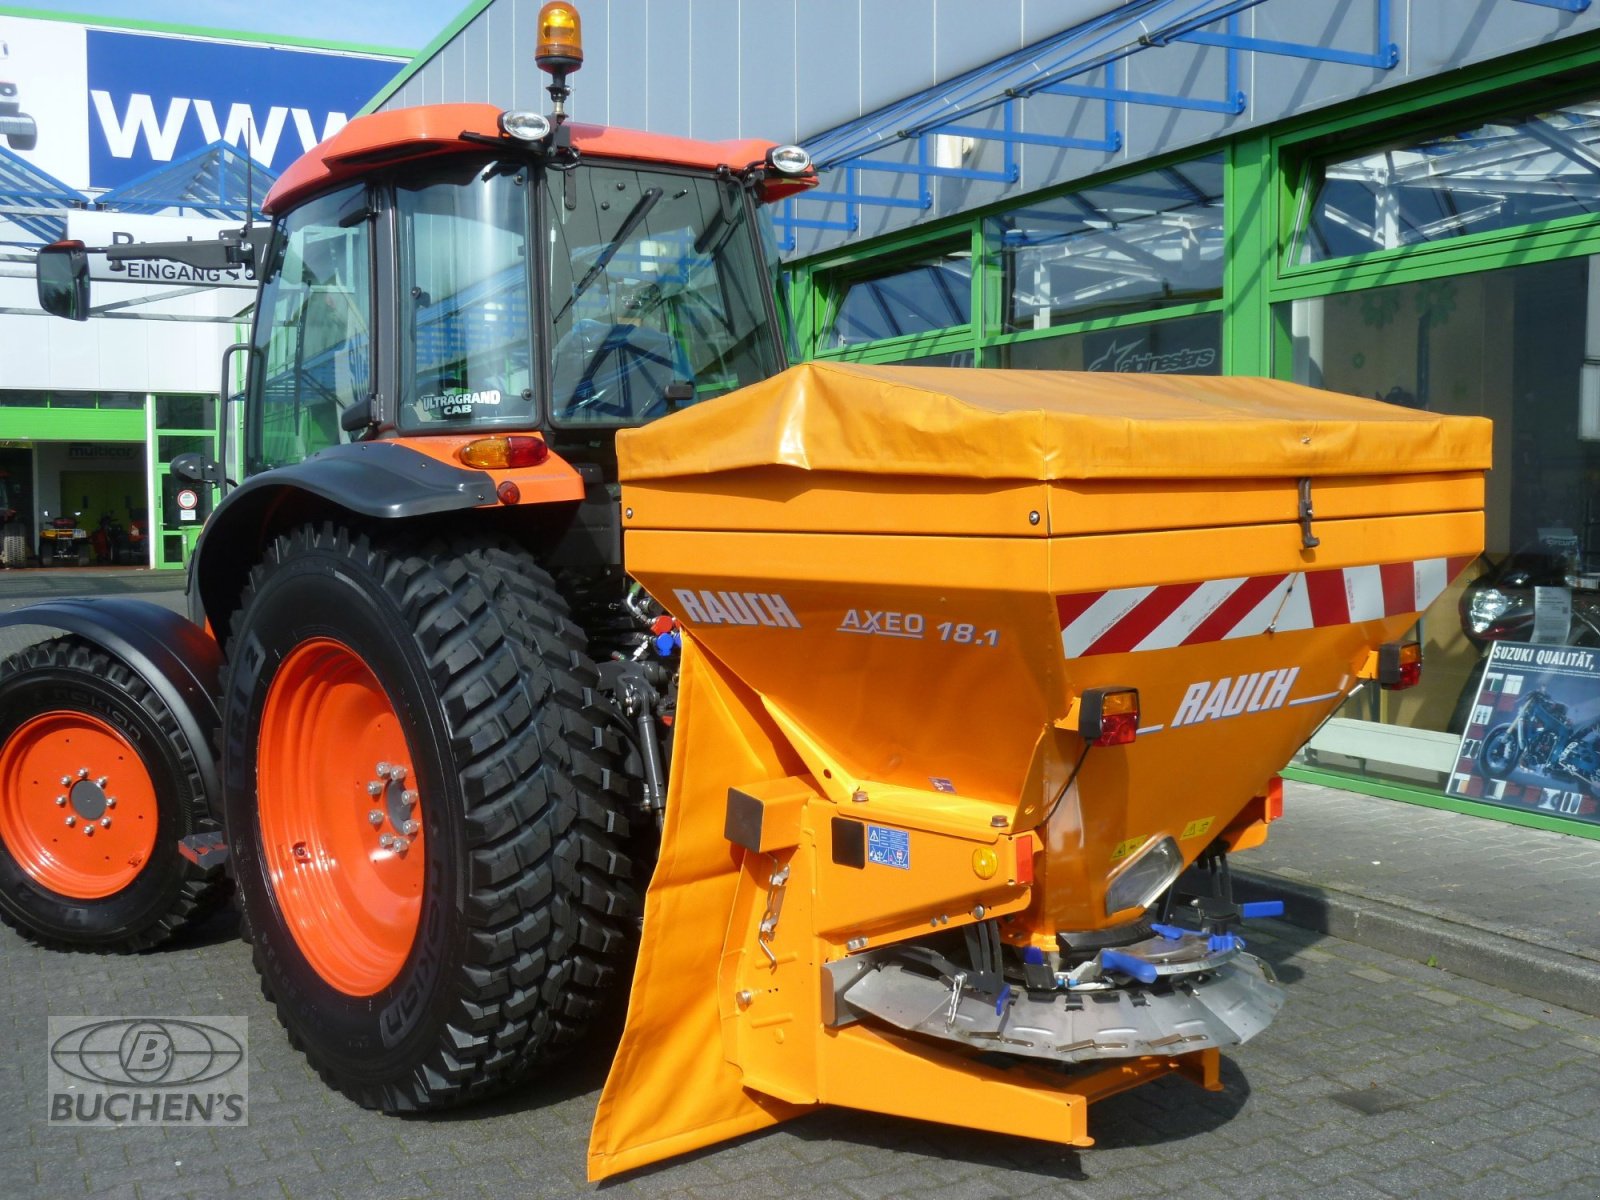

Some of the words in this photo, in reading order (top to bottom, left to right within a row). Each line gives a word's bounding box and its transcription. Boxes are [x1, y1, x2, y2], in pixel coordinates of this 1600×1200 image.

[127, 263, 221, 282] EINGANG
[421, 390, 501, 411] ULTRAGRAND
[443, 404, 472, 415] CAB
[672, 588, 802, 628] RAUCH
[839, 608, 924, 635] AXEO
[936, 621, 999, 646] 18.1
[1493, 645, 1535, 663] SUZUKI
[1536, 649, 1595, 671] QUALITÄT,
[1170, 666, 1301, 728] RAUCH
